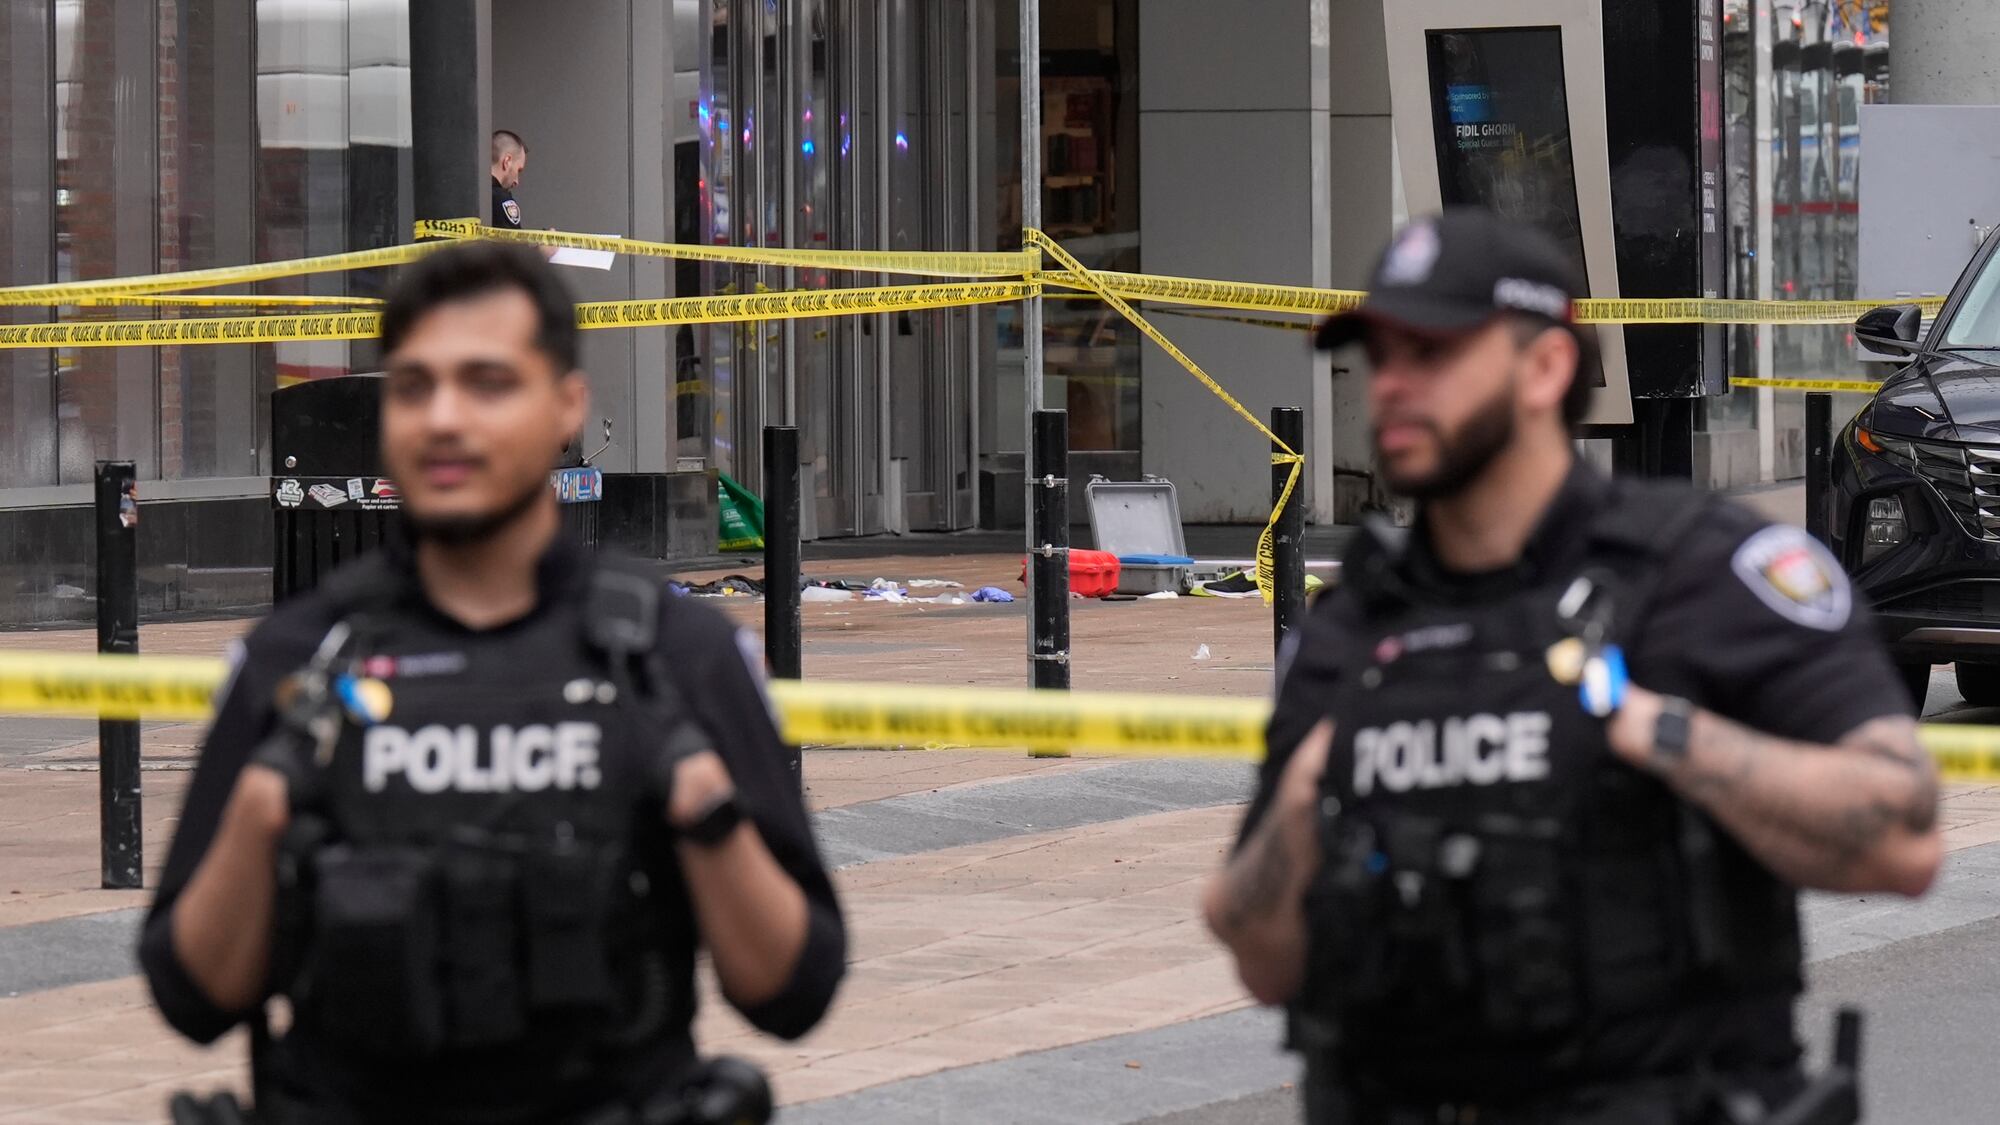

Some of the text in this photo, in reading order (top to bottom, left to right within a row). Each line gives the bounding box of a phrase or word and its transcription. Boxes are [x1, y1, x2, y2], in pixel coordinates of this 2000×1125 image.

[1456, 124, 1480, 137] FIDIL
[363, 721, 601, 793] POLICE
[1353, 711, 1551, 796] POLICE
